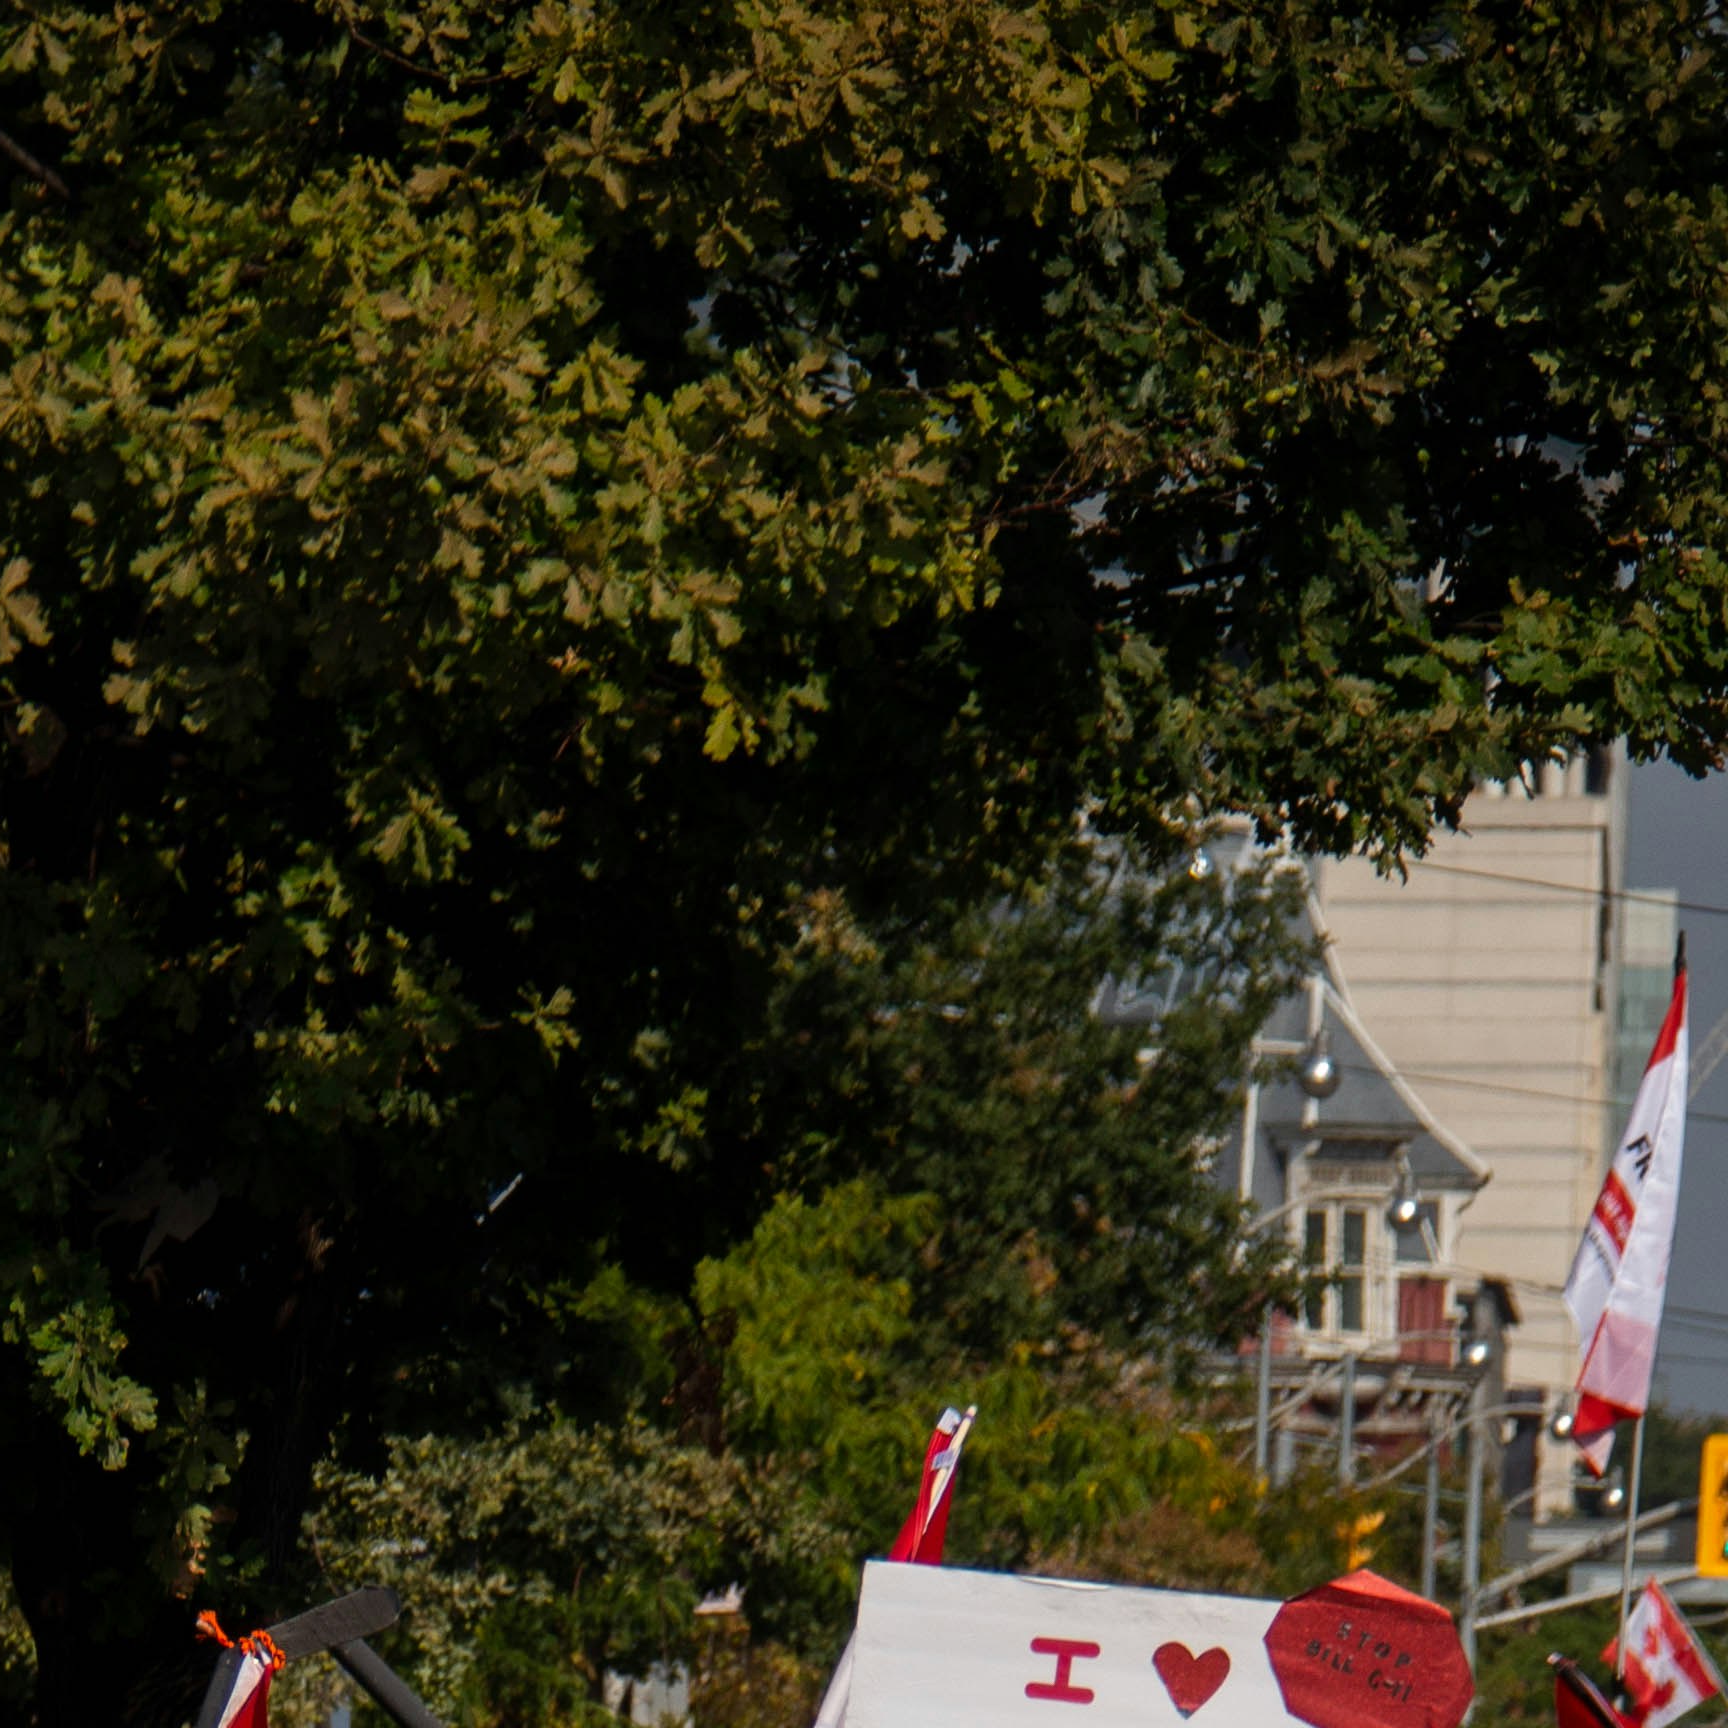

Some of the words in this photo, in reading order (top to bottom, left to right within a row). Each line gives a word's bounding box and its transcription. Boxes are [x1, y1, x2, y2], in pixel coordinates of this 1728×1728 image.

[1025, 1637, 1101, 1704] I
[1305, 1638, 1354, 1675] BILL
[1366, 1668, 1414, 1705] C-11
[1337, 1621, 1412, 1668] STOP
